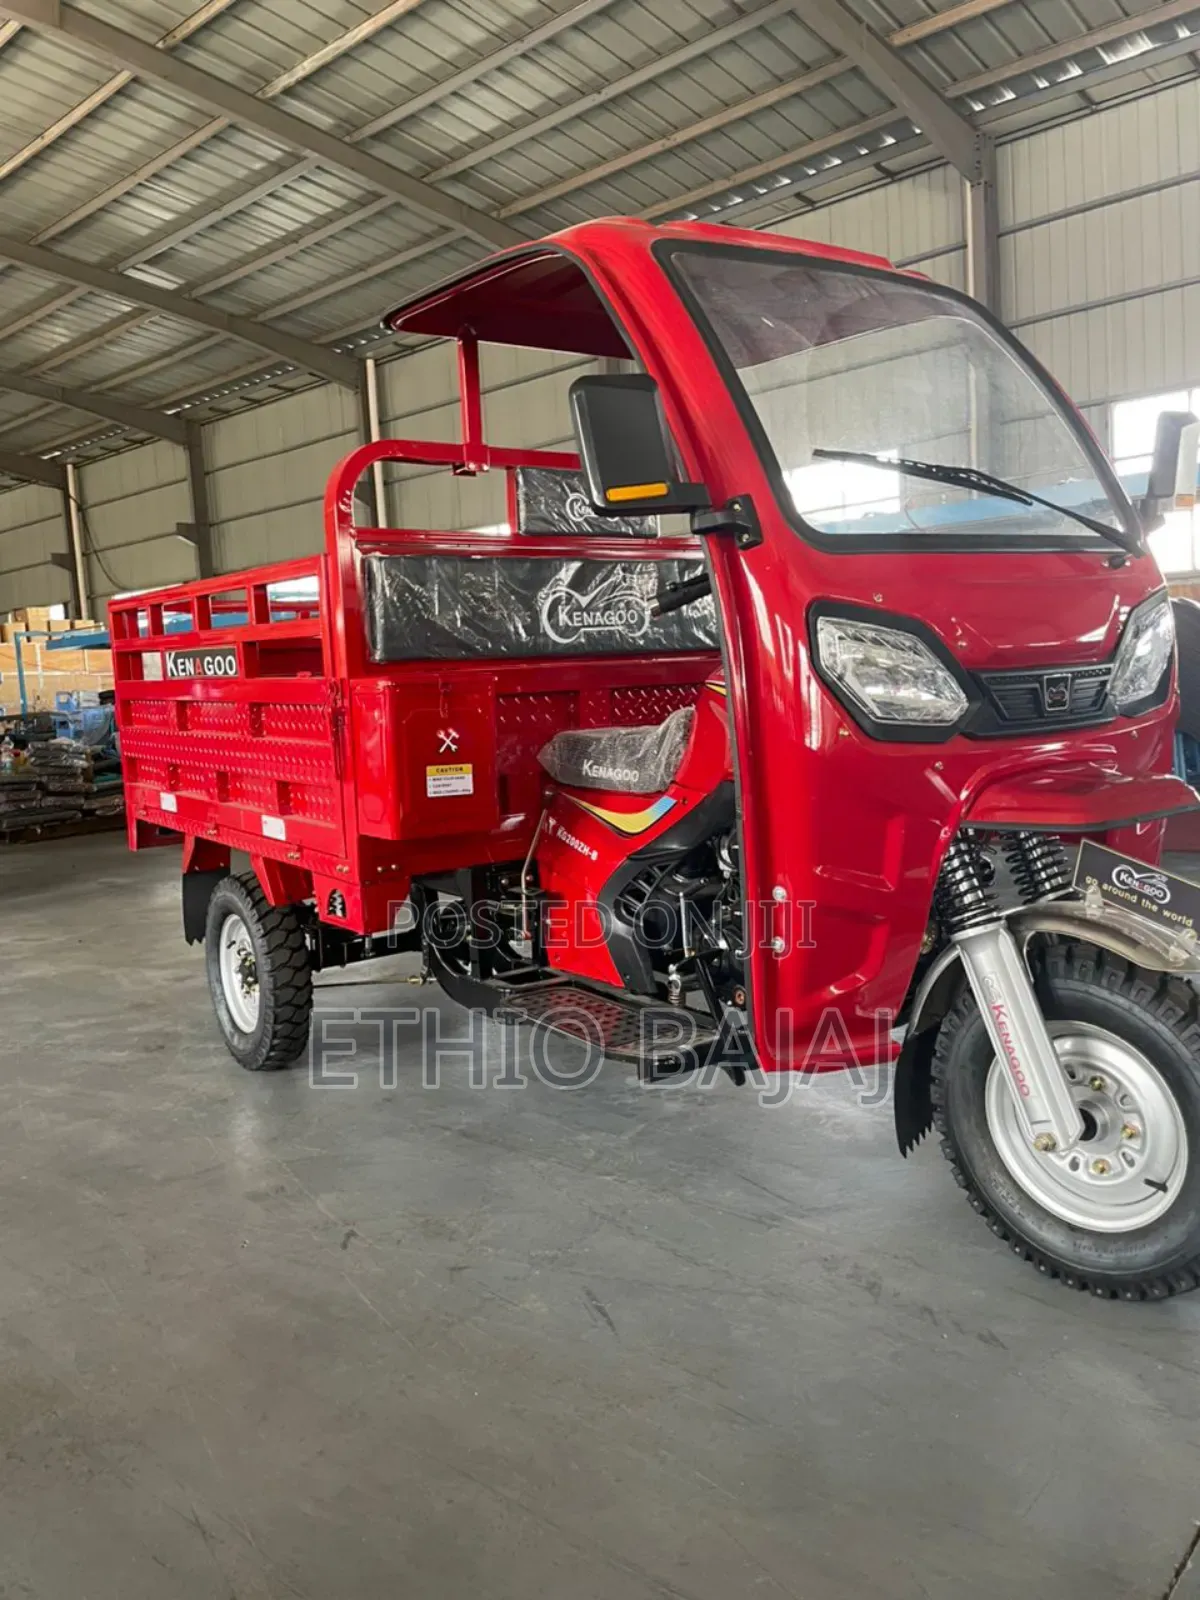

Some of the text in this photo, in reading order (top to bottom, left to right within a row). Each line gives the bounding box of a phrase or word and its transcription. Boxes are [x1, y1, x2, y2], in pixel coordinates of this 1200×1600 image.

[558, 605, 639, 627] KENAGOO
[166, 651, 236, 677] KENAGOO
[582, 759, 640, 782] KENAGOO
[1102, 882, 1138, 903] around
[1141, 898, 1158, 912] the
[1162, 908, 1194, 927] world
[991, 1003, 1030, 1097] KENAGOO
